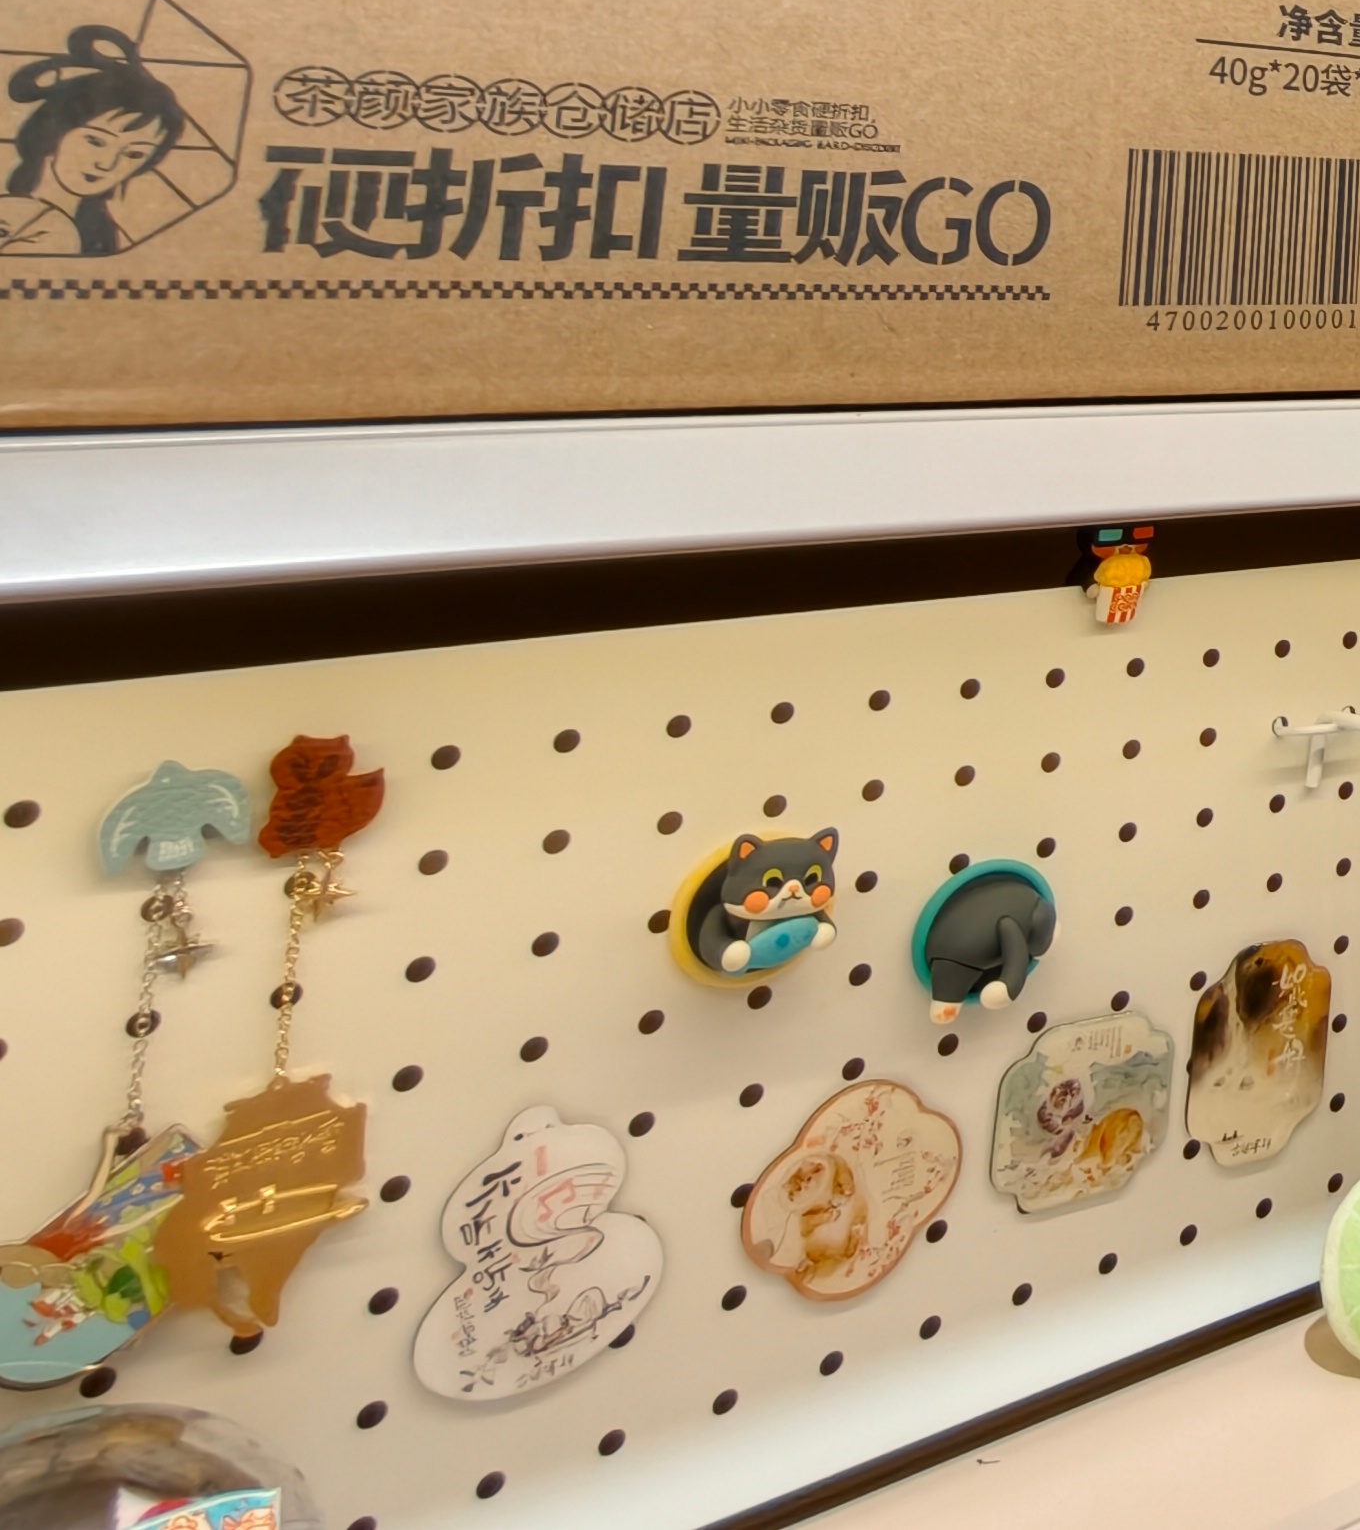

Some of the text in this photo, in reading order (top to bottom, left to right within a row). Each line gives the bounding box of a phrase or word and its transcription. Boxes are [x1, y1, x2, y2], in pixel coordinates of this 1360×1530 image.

[273, 66, 723, 145] 茶颜家族仓储店
